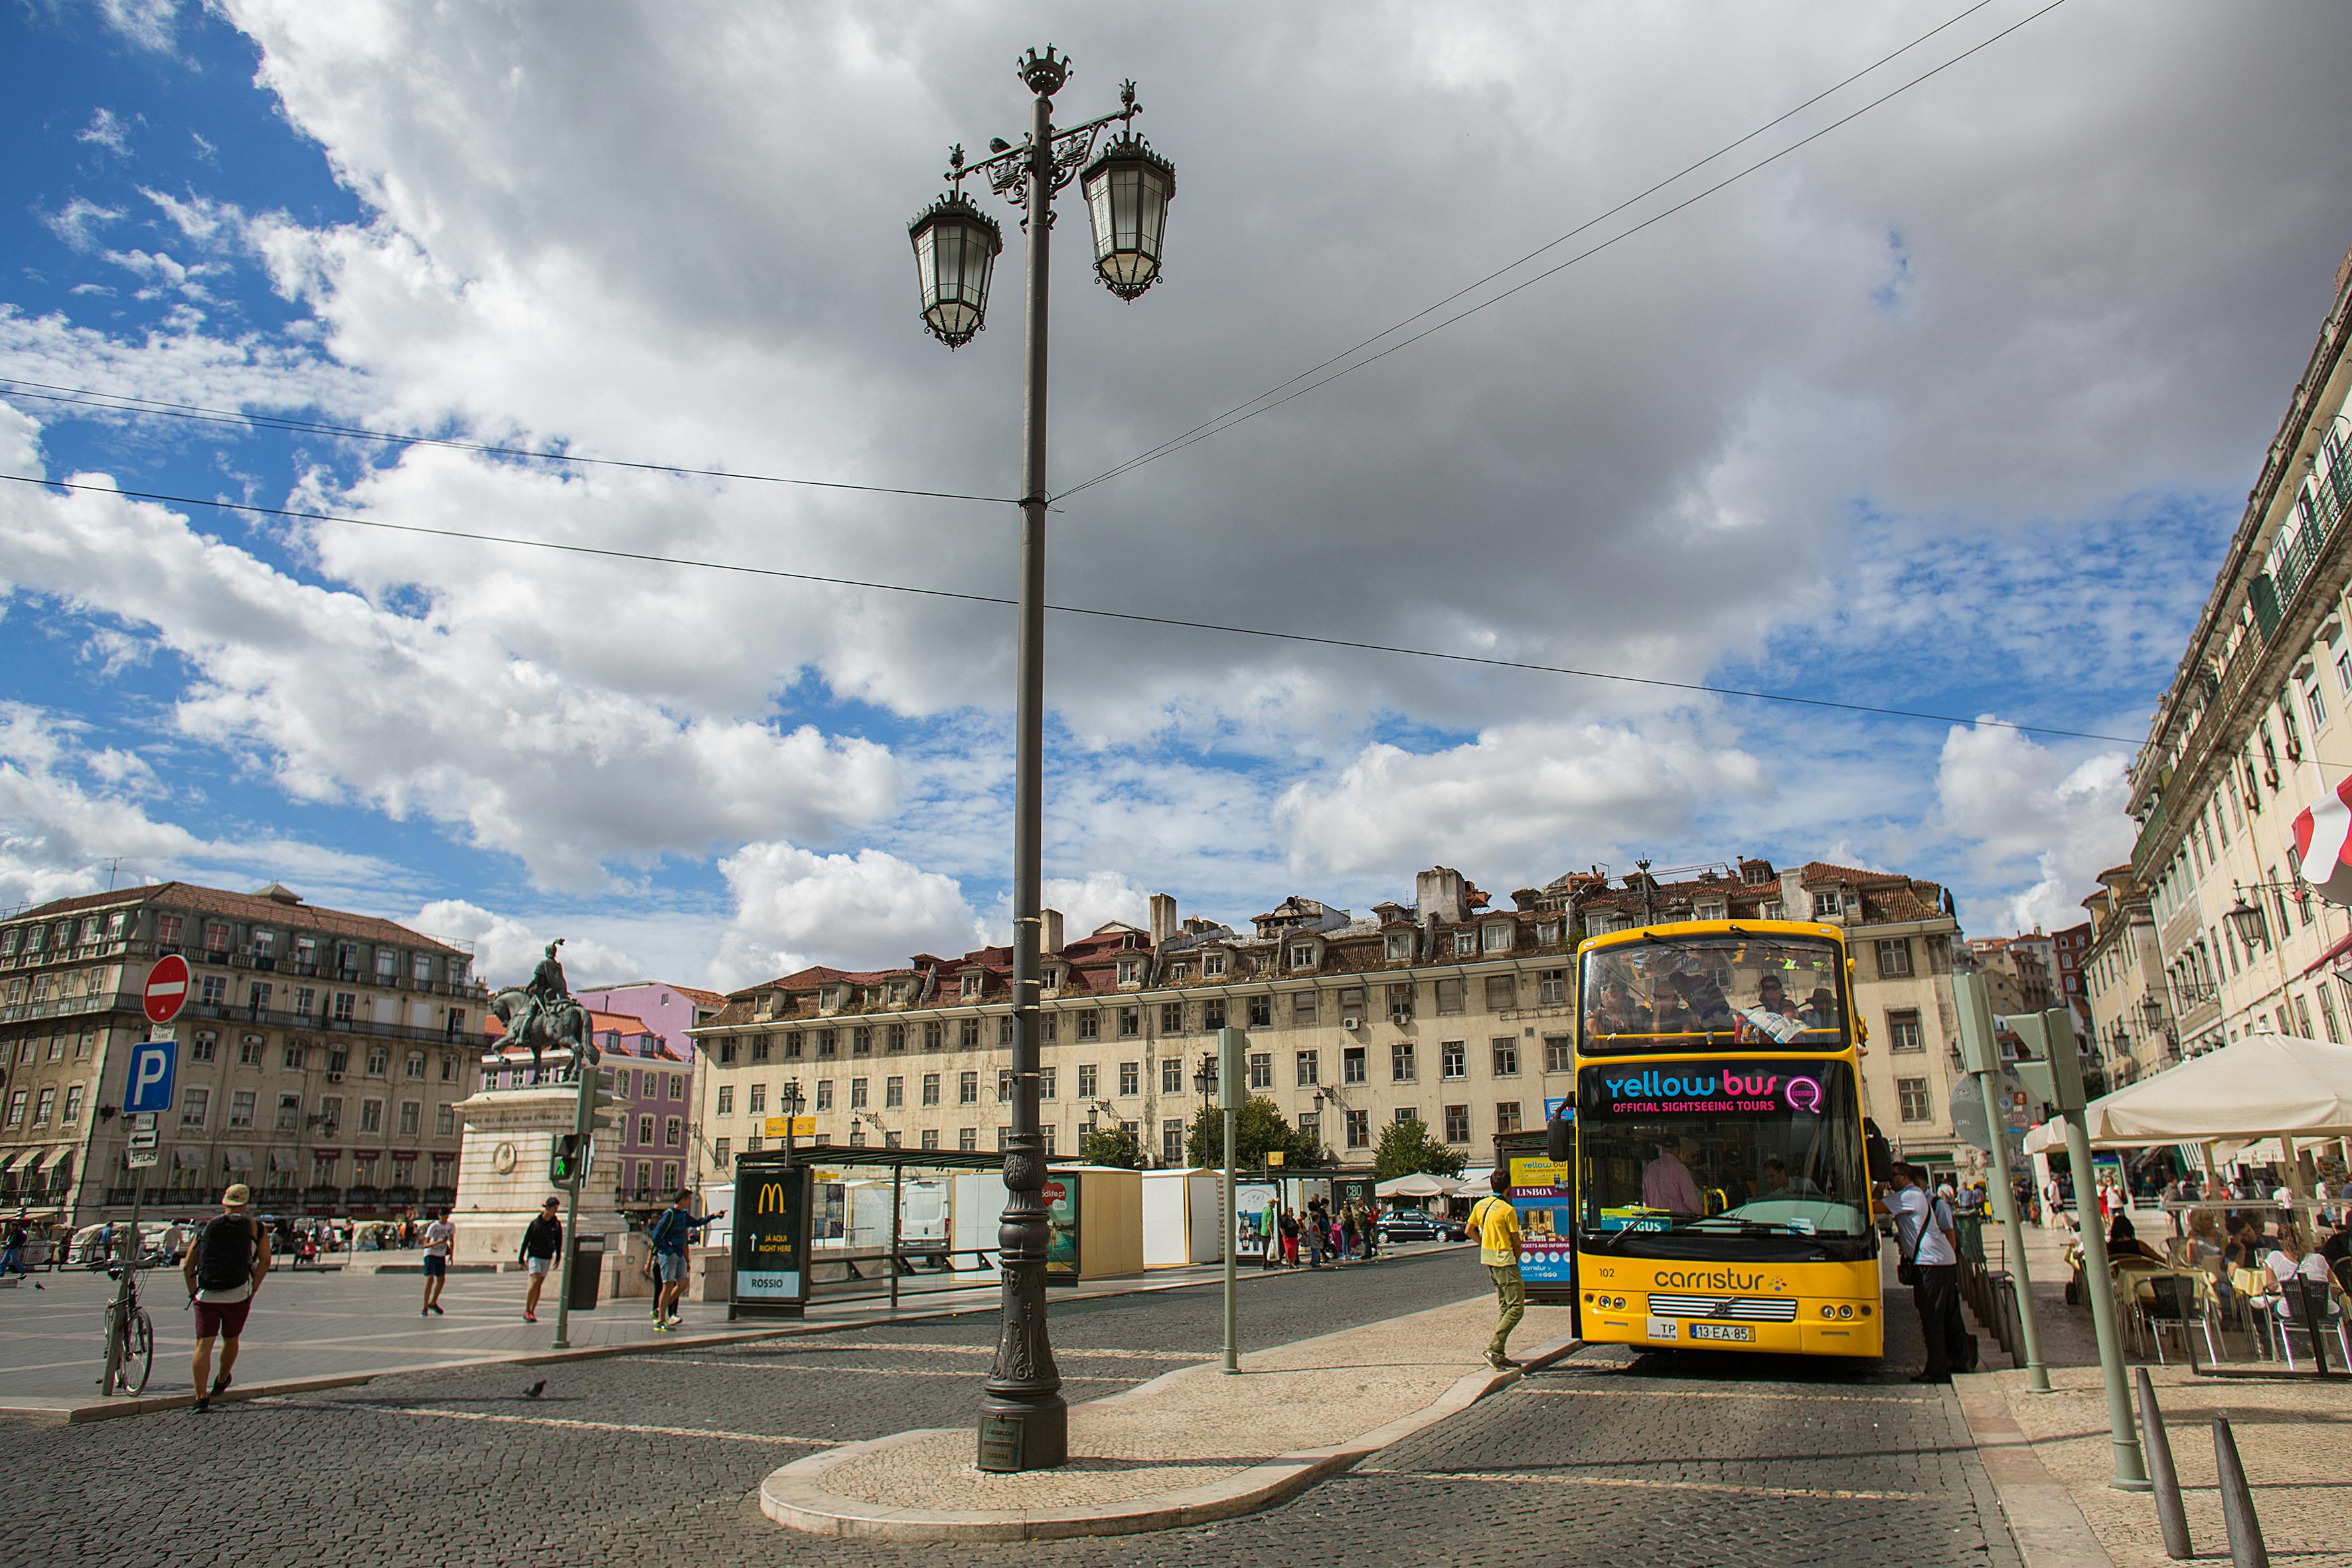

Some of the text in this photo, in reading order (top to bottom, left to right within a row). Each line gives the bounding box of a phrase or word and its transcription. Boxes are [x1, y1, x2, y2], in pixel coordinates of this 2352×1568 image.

[133, 1050, 166, 1105] P
[1723, 1069, 1778, 1096] bus
[1613, 1100, 1775, 1113] OFFICIAL SIGHTSEEING TOURS
[765, 1233, 771, 1242] JÁ
[1599, 1269, 1614, 1278] 102
[751, 1279, 783, 1288] ROSSIO
[1654, 1268, 1764, 1291] carristur
[1660, 1324, 1676, 1334] TP
